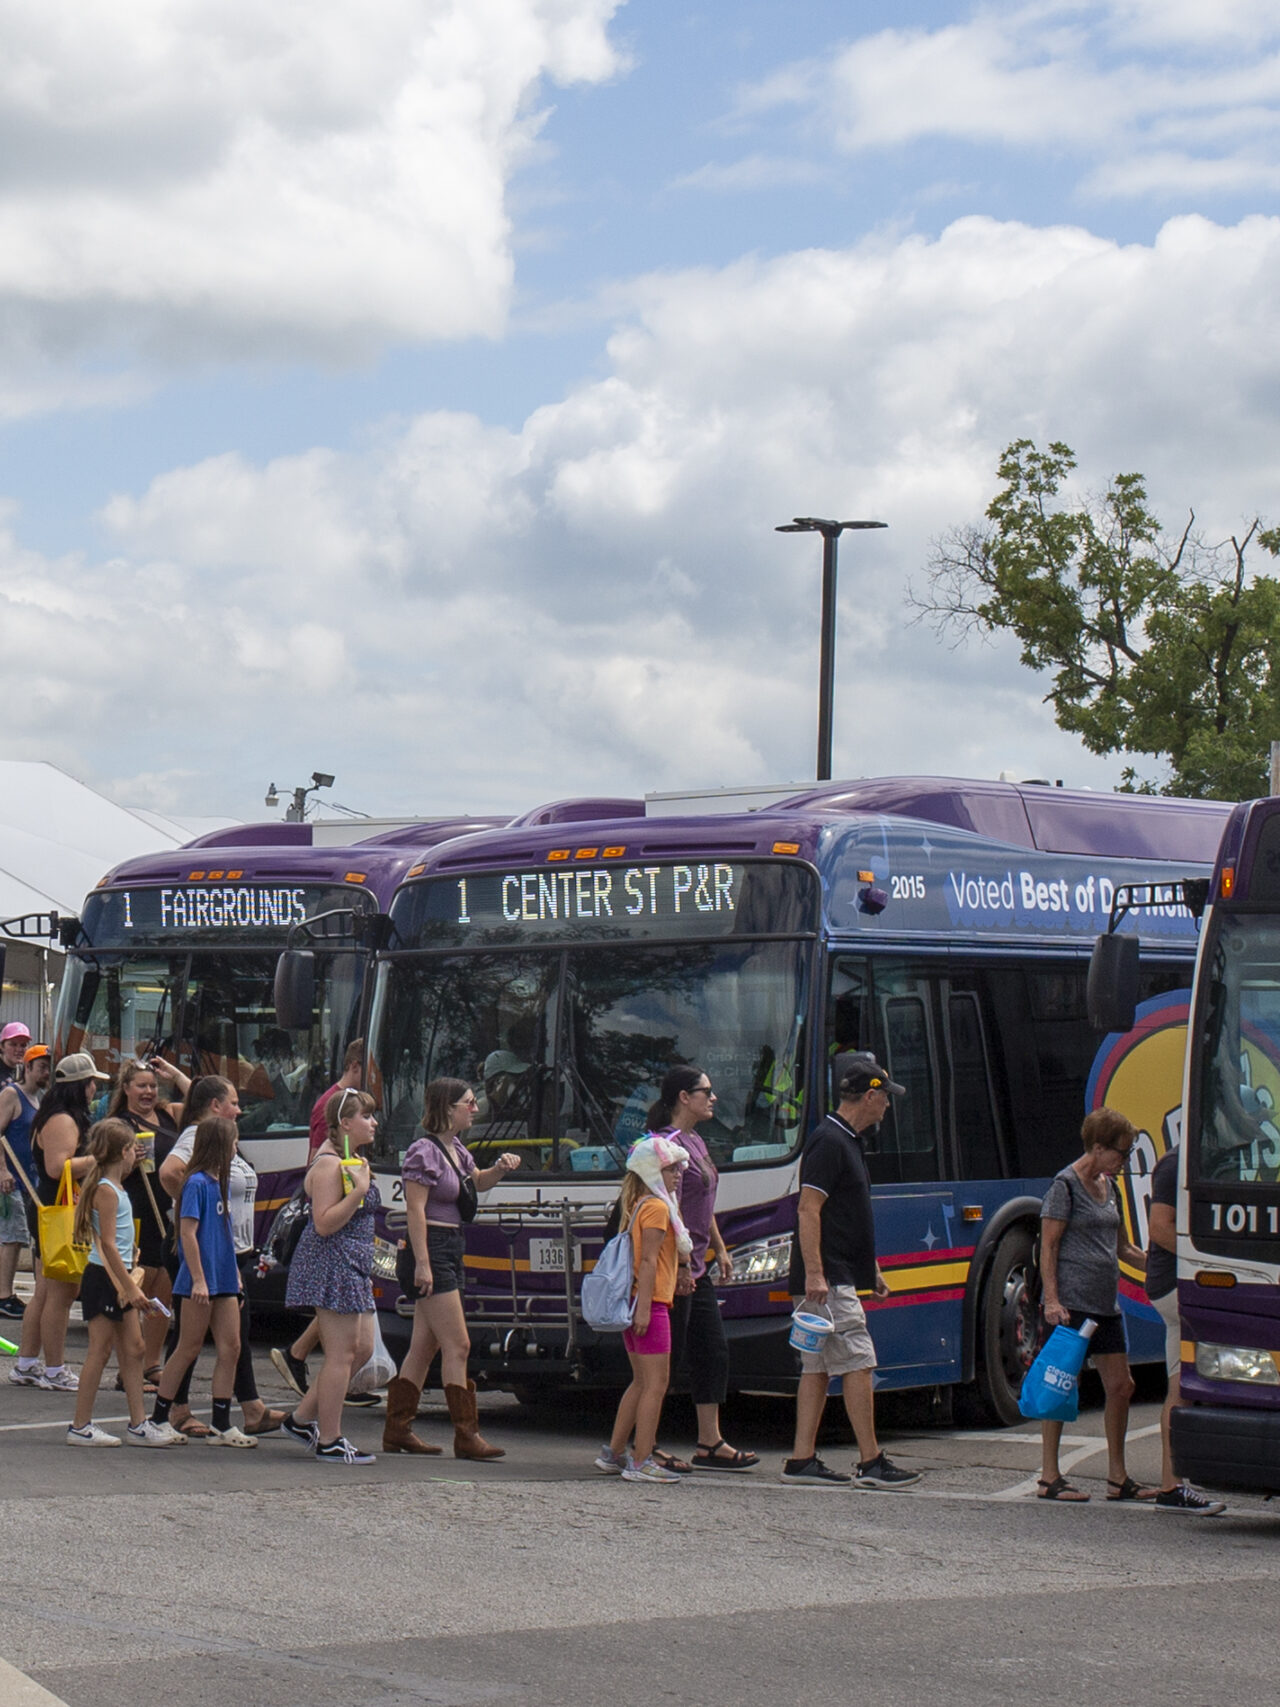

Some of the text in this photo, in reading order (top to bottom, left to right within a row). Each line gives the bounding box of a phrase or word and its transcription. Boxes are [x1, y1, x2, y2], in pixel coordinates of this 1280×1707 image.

[123, 888, 306, 927] 1 FAIRGROUNDS
[457, 864, 735, 923] 1 CENTER ST P&R
[891, 875, 926, 899] 2015
[950, 872, 1015, 909] Voted
[1020, 872, 1070, 912] Best
[1075, 876, 1095, 914] of
[1145, 880, 1203, 919] Moin
